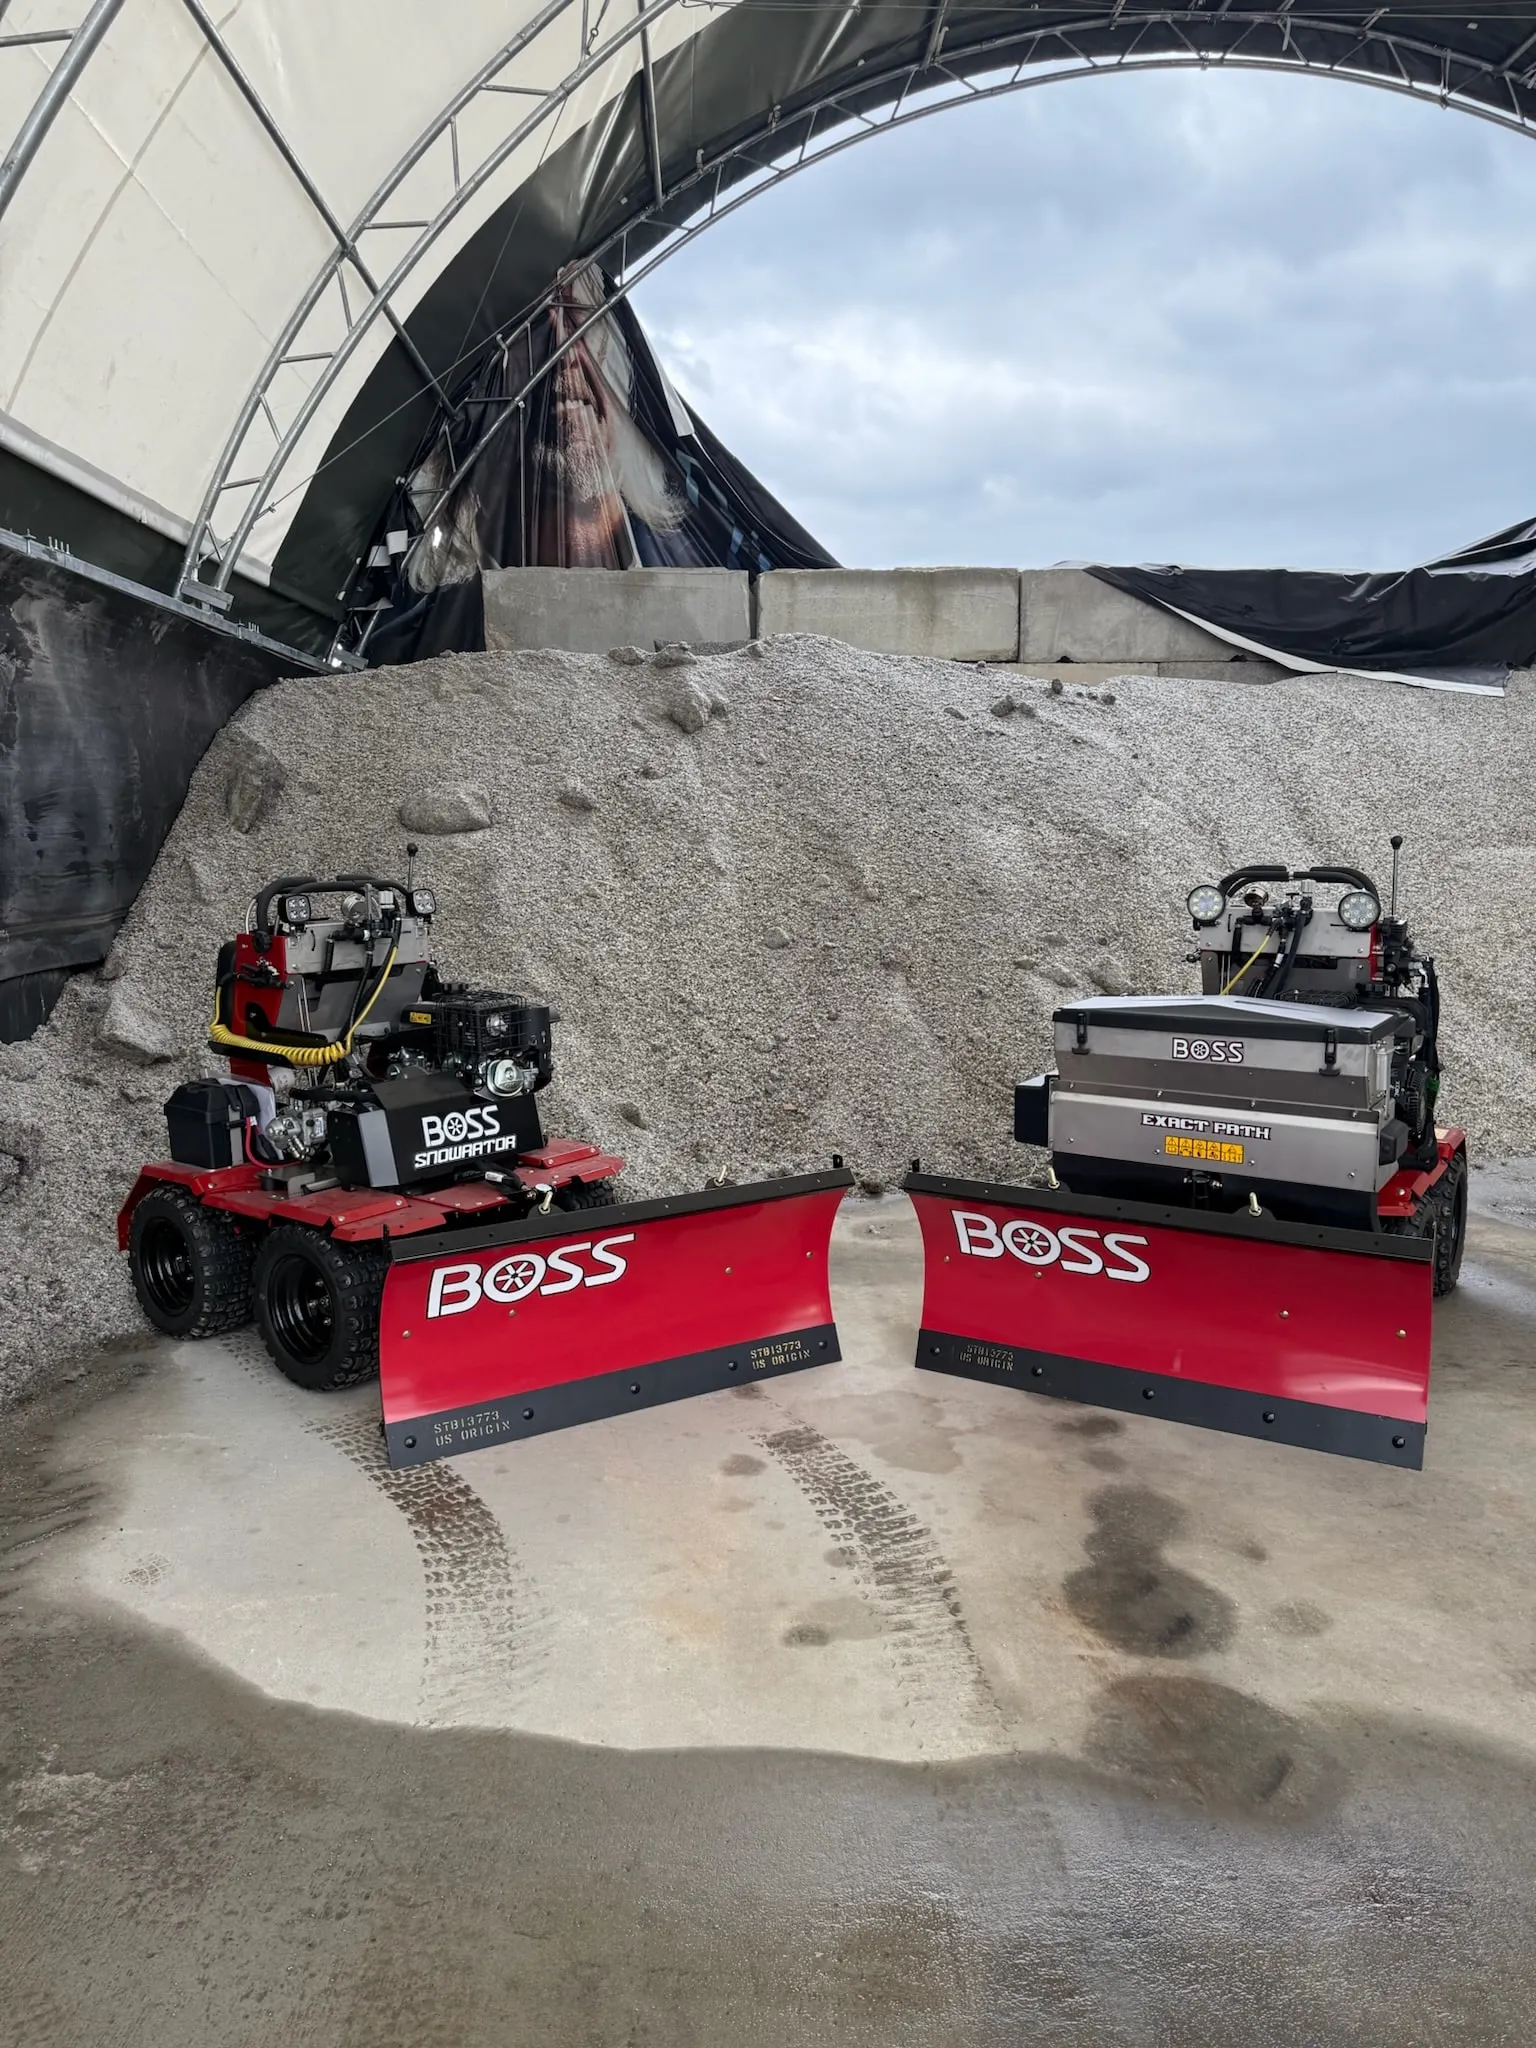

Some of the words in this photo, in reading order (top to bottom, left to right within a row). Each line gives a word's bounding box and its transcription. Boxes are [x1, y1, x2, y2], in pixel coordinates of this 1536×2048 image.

[1171, 1037, 1244, 1063] BOSS
[421, 1104, 501, 1148] BOSS
[1141, 1113, 1209, 1132] EXACT
[1213, 1121, 1271, 1140] PATH
[414, 1135, 517, 1168] SNOWRATOR
[951, 1209, 1151, 1283] BOSS
[426, 1232, 636, 1319] BOSS
[750, 1340, 802, 1359] STB13773
[752, 1359, 766, 1370] US
[771, 1349, 811, 1366] ORIGIN
[433, 1410, 500, 1434] STB13773
[435, 1433, 453, 1447] US
[460, 1420, 511, 1441] ORIGIN
